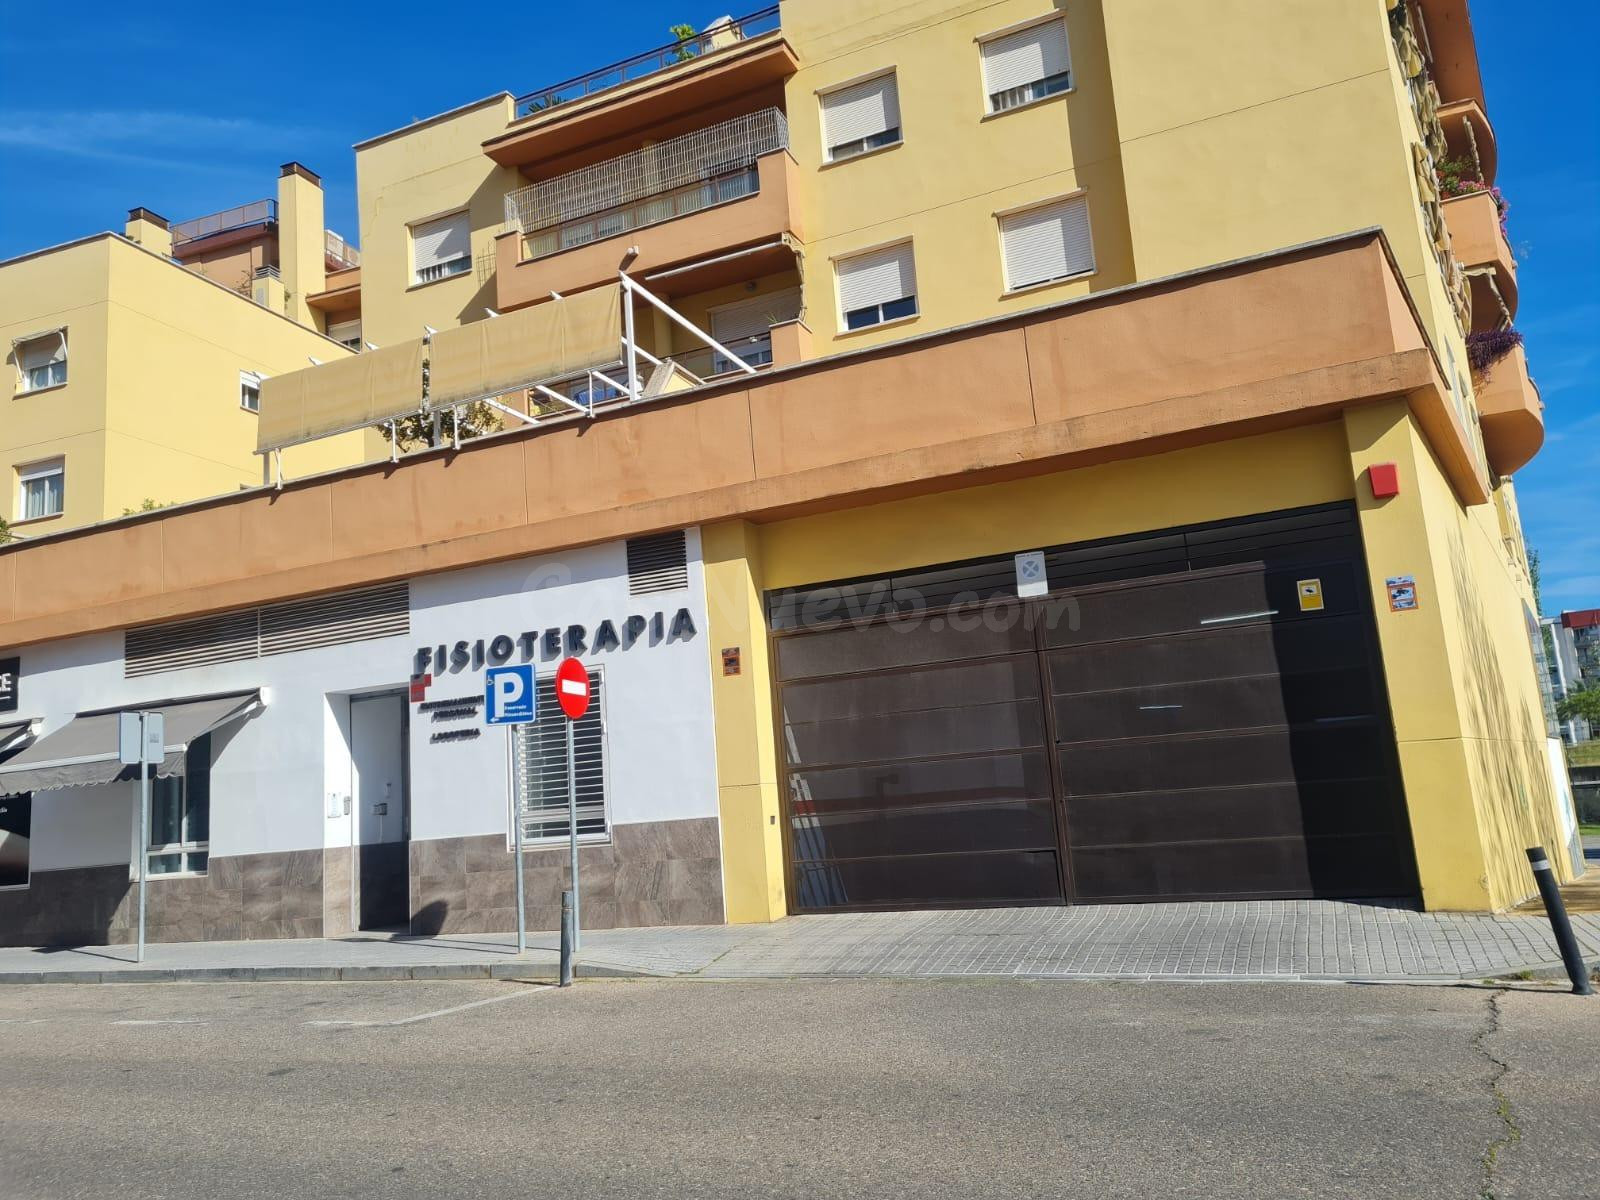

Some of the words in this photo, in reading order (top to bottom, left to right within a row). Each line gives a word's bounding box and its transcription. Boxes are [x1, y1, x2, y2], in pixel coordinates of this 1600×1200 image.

[413, 607, 698, 678] FISIOTERAPIA
[0, 672, 12, 692] E
[494, 672, 524, 718] P
